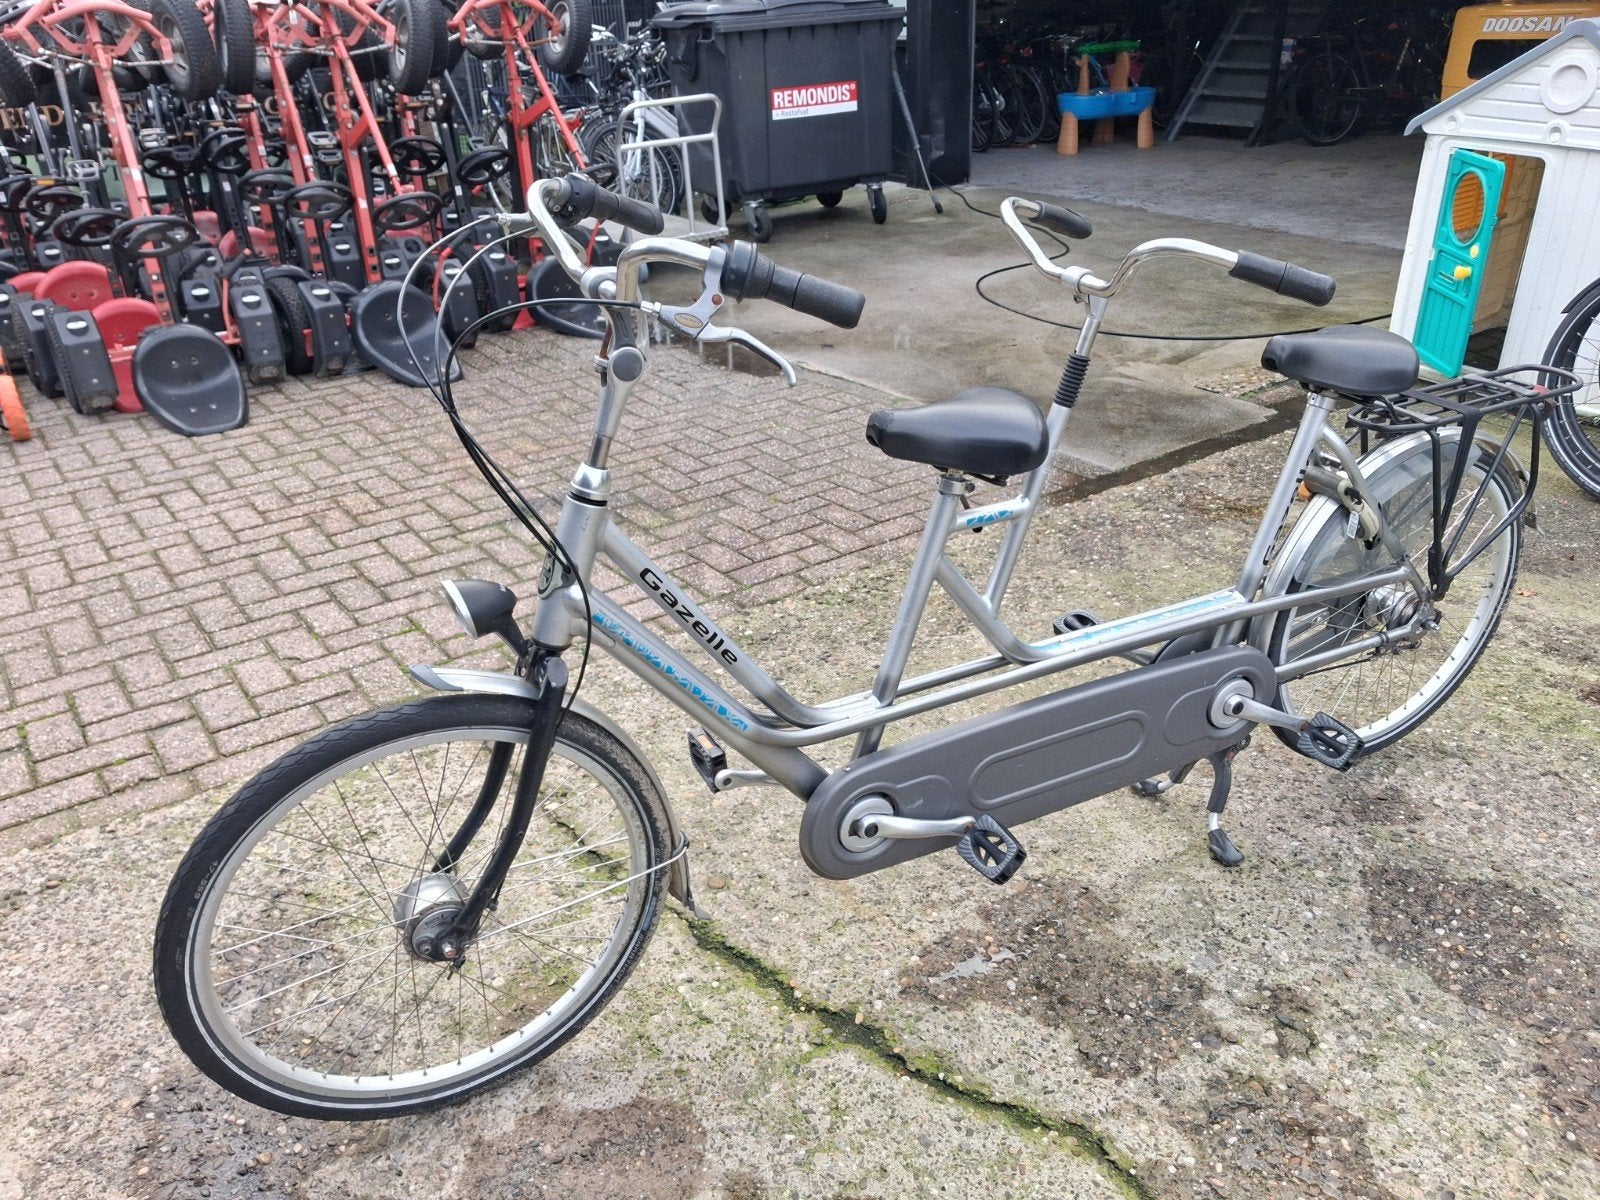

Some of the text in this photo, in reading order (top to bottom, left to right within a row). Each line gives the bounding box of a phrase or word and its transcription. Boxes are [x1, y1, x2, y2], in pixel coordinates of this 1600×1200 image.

[1482, 15, 1575, 32] DOOSAN
[773, 84, 851, 108] REMONDIS
[639, 567, 738, 666] Gazelle
